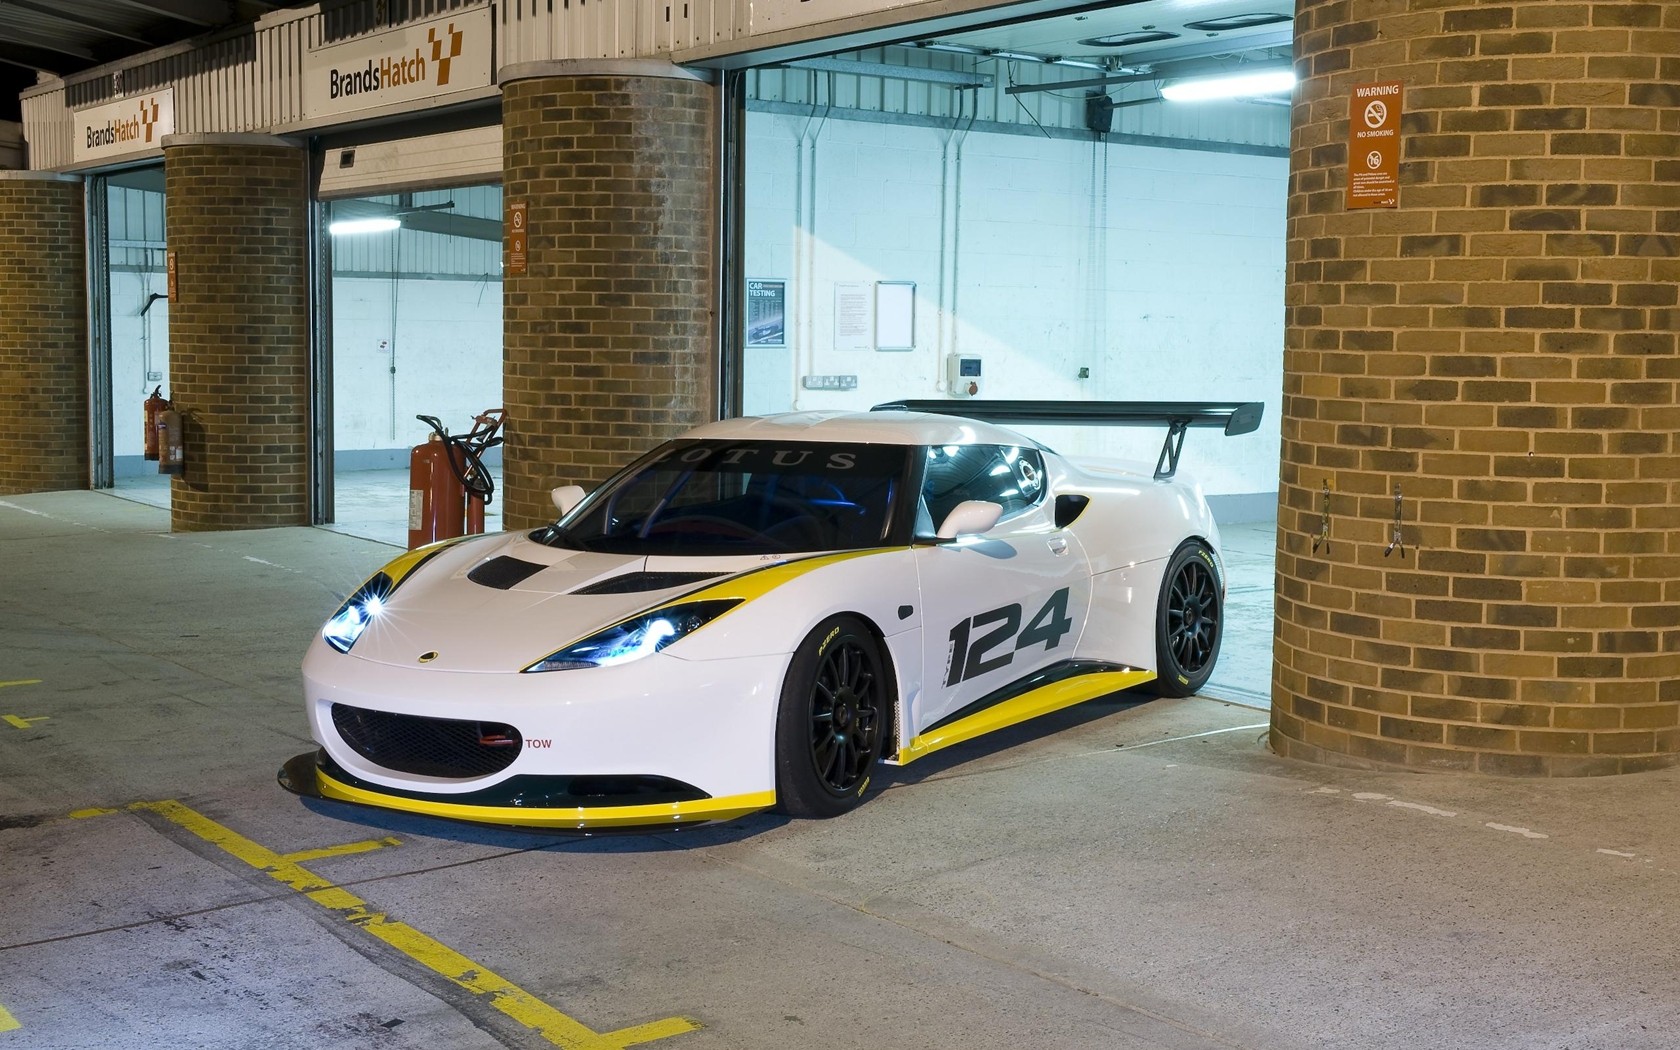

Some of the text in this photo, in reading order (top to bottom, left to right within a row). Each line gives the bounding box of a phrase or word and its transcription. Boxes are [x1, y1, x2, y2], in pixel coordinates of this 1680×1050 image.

[330, 48, 425, 99] BrandsHatch
[1356, 84, 1399, 97] WARNING
[86, 113, 140, 148] BrandsHatch
[1367, 129, 1394, 137] SMOKING
[749, 282, 763, 290] CAR
[946, 586, 1072, 688] 124
[525, 739, 552, 749] TOW
